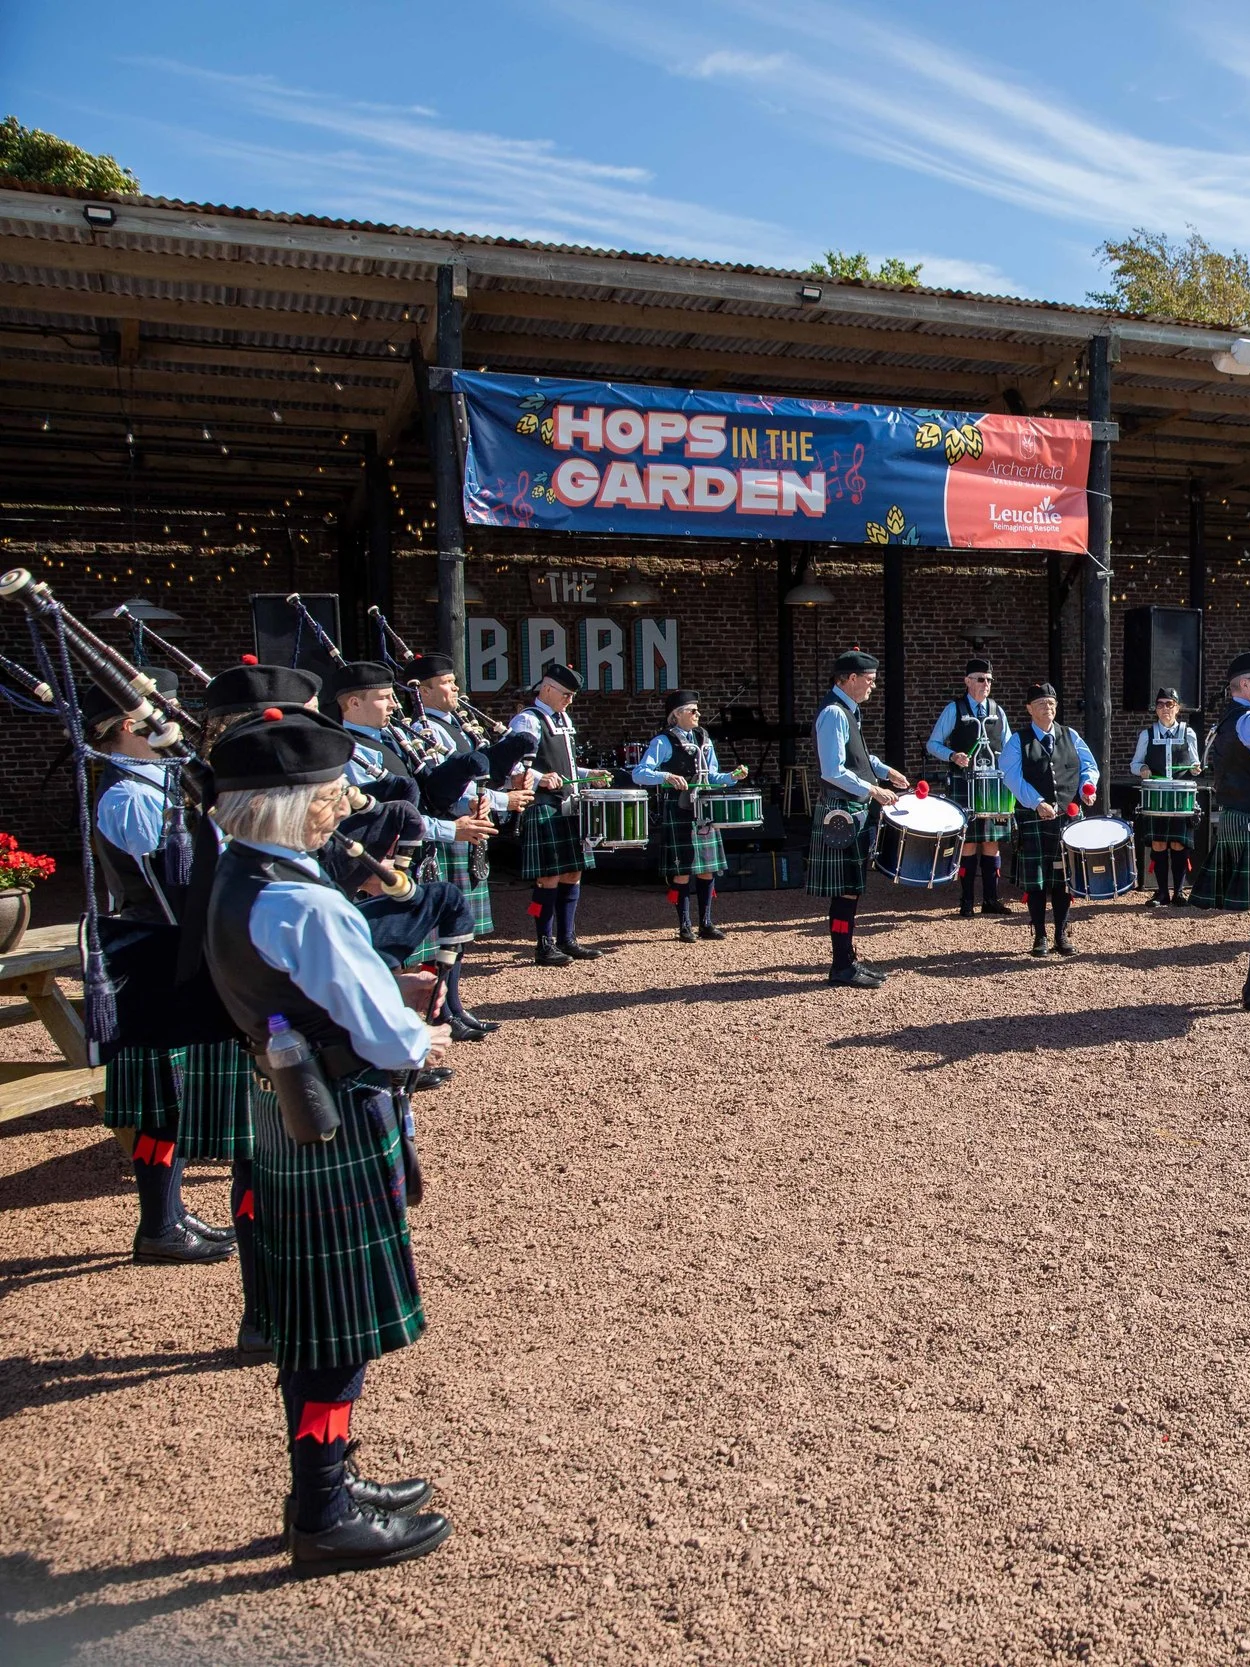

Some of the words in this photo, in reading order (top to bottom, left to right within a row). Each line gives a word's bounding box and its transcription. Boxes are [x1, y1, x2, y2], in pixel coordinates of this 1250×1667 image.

[553, 404, 728, 458] HOPS
[732, 427, 757, 459] IN
[765, 429, 814, 461] THE
[986, 459, 1064, 480] Archerfield
[551, 458, 827, 518] GARDEN
[989, 502, 1062, 524] Leuchie
[993, 522, 1034, 533] Reimagining
[1034, 525, 1060, 533] Respite
[546, 571, 597, 603] THE
[466, 617, 679, 694] BARN
